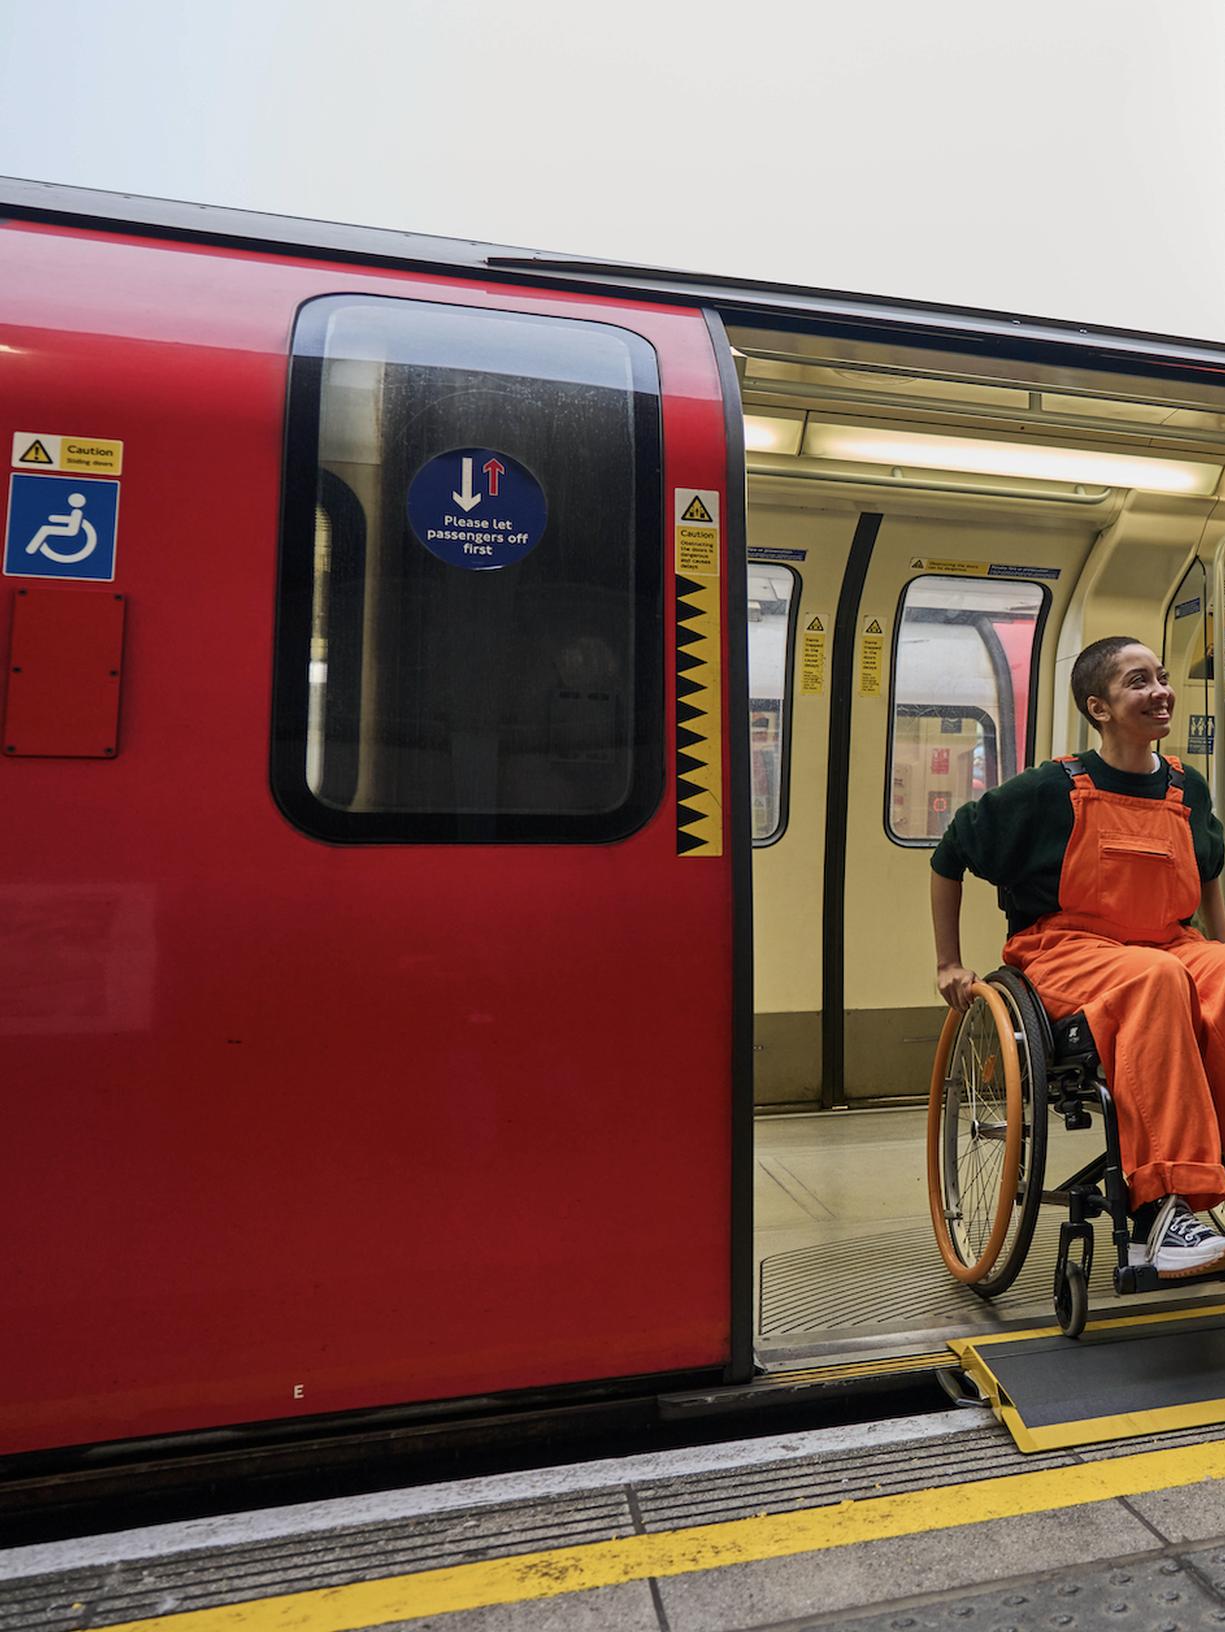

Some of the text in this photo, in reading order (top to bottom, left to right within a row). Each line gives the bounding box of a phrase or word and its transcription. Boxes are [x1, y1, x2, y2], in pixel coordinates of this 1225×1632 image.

[67, 444, 113, 457] Caution
[444, 515, 513, 530] Please let
[427, 529, 529, 544] passengers off
[680, 529, 714, 539] Caution
[463, 542, 493, 555] first
[294, 1384, 304, 1399] E
